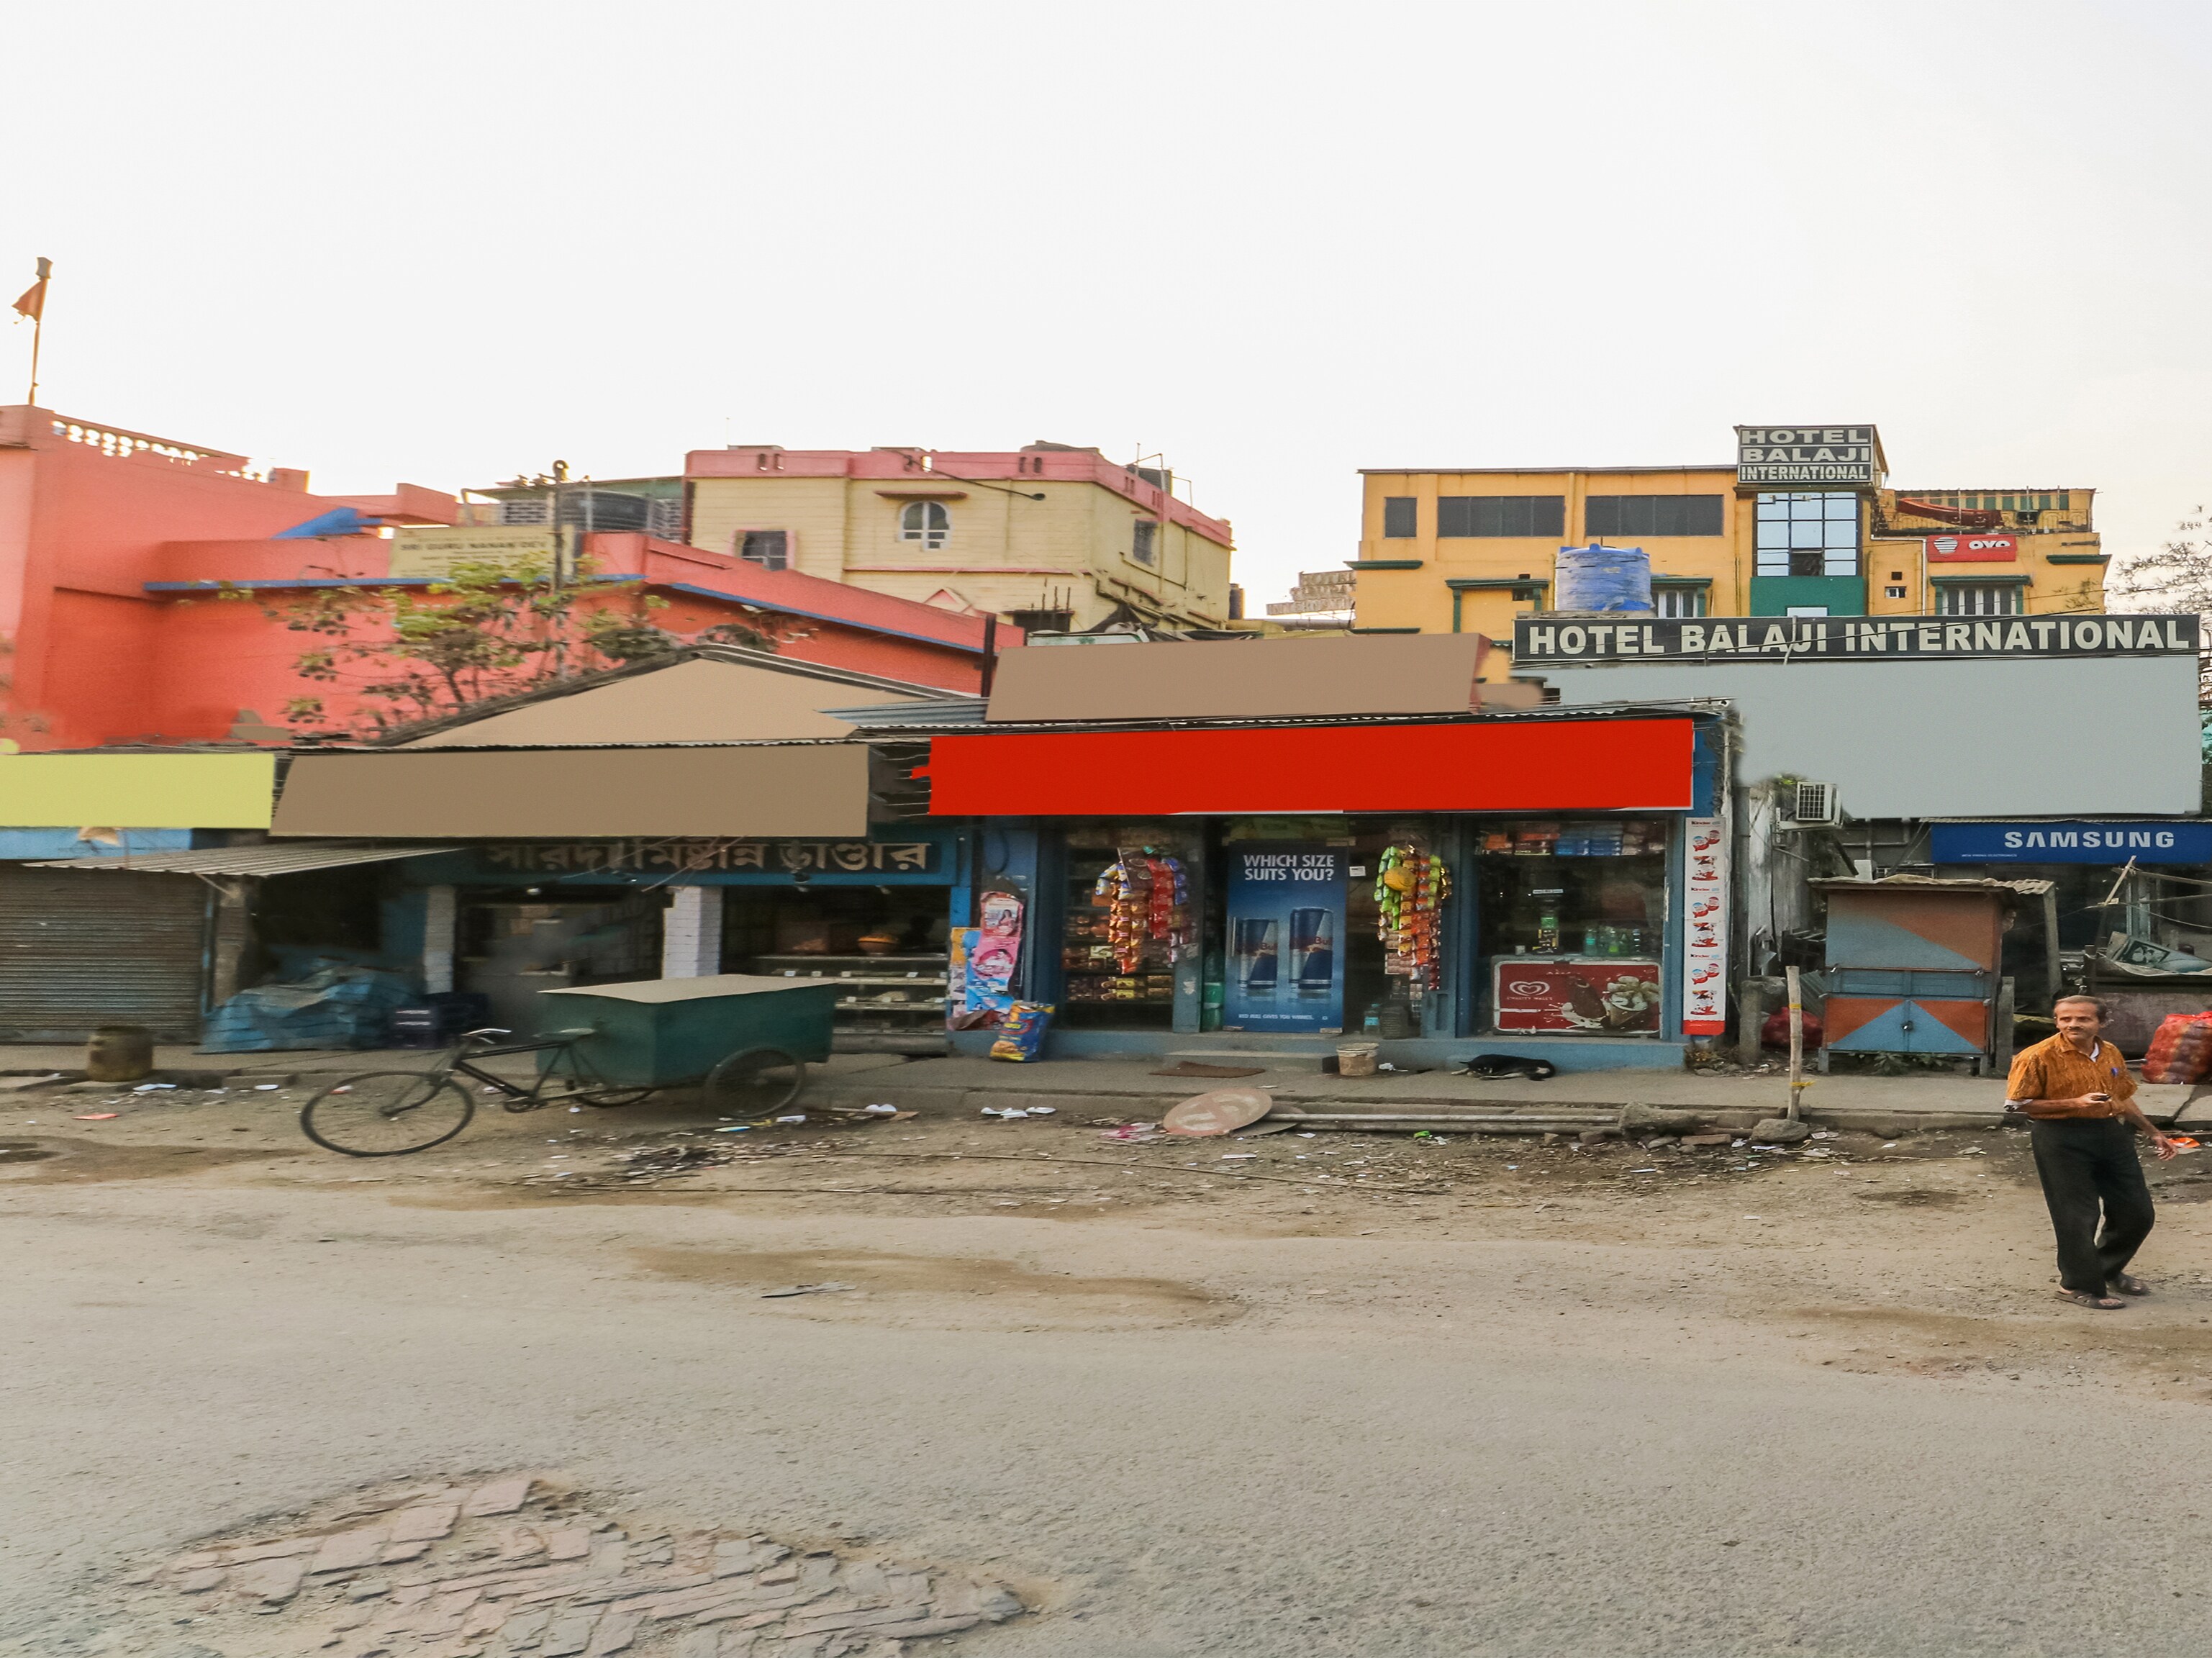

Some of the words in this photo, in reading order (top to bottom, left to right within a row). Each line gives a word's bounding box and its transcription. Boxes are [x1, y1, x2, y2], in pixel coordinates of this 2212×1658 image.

[1741, 429, 1869, 444] HOTEL
[1742, 448, 1869, 462] BALAJI
[1741, 466, 1868, 480] INTERNATIONAL
[1968, 540, 2011, 550] OYO
[1528, 625, 1665, 656] HOTEL
[1680, 623, 1828, 655] BALAJI
[1845, 620, 2189, 652] INTERNATIONAL
[2004, 831, 2175, 848] SAMSUNG
[1243, 855, 1297, 867] WHICH
[1302, 855, 1335, 867] SIZE
[1244, 868, 1287, 881] SUITS
[1292, 868, 1334, 882] YOU?
